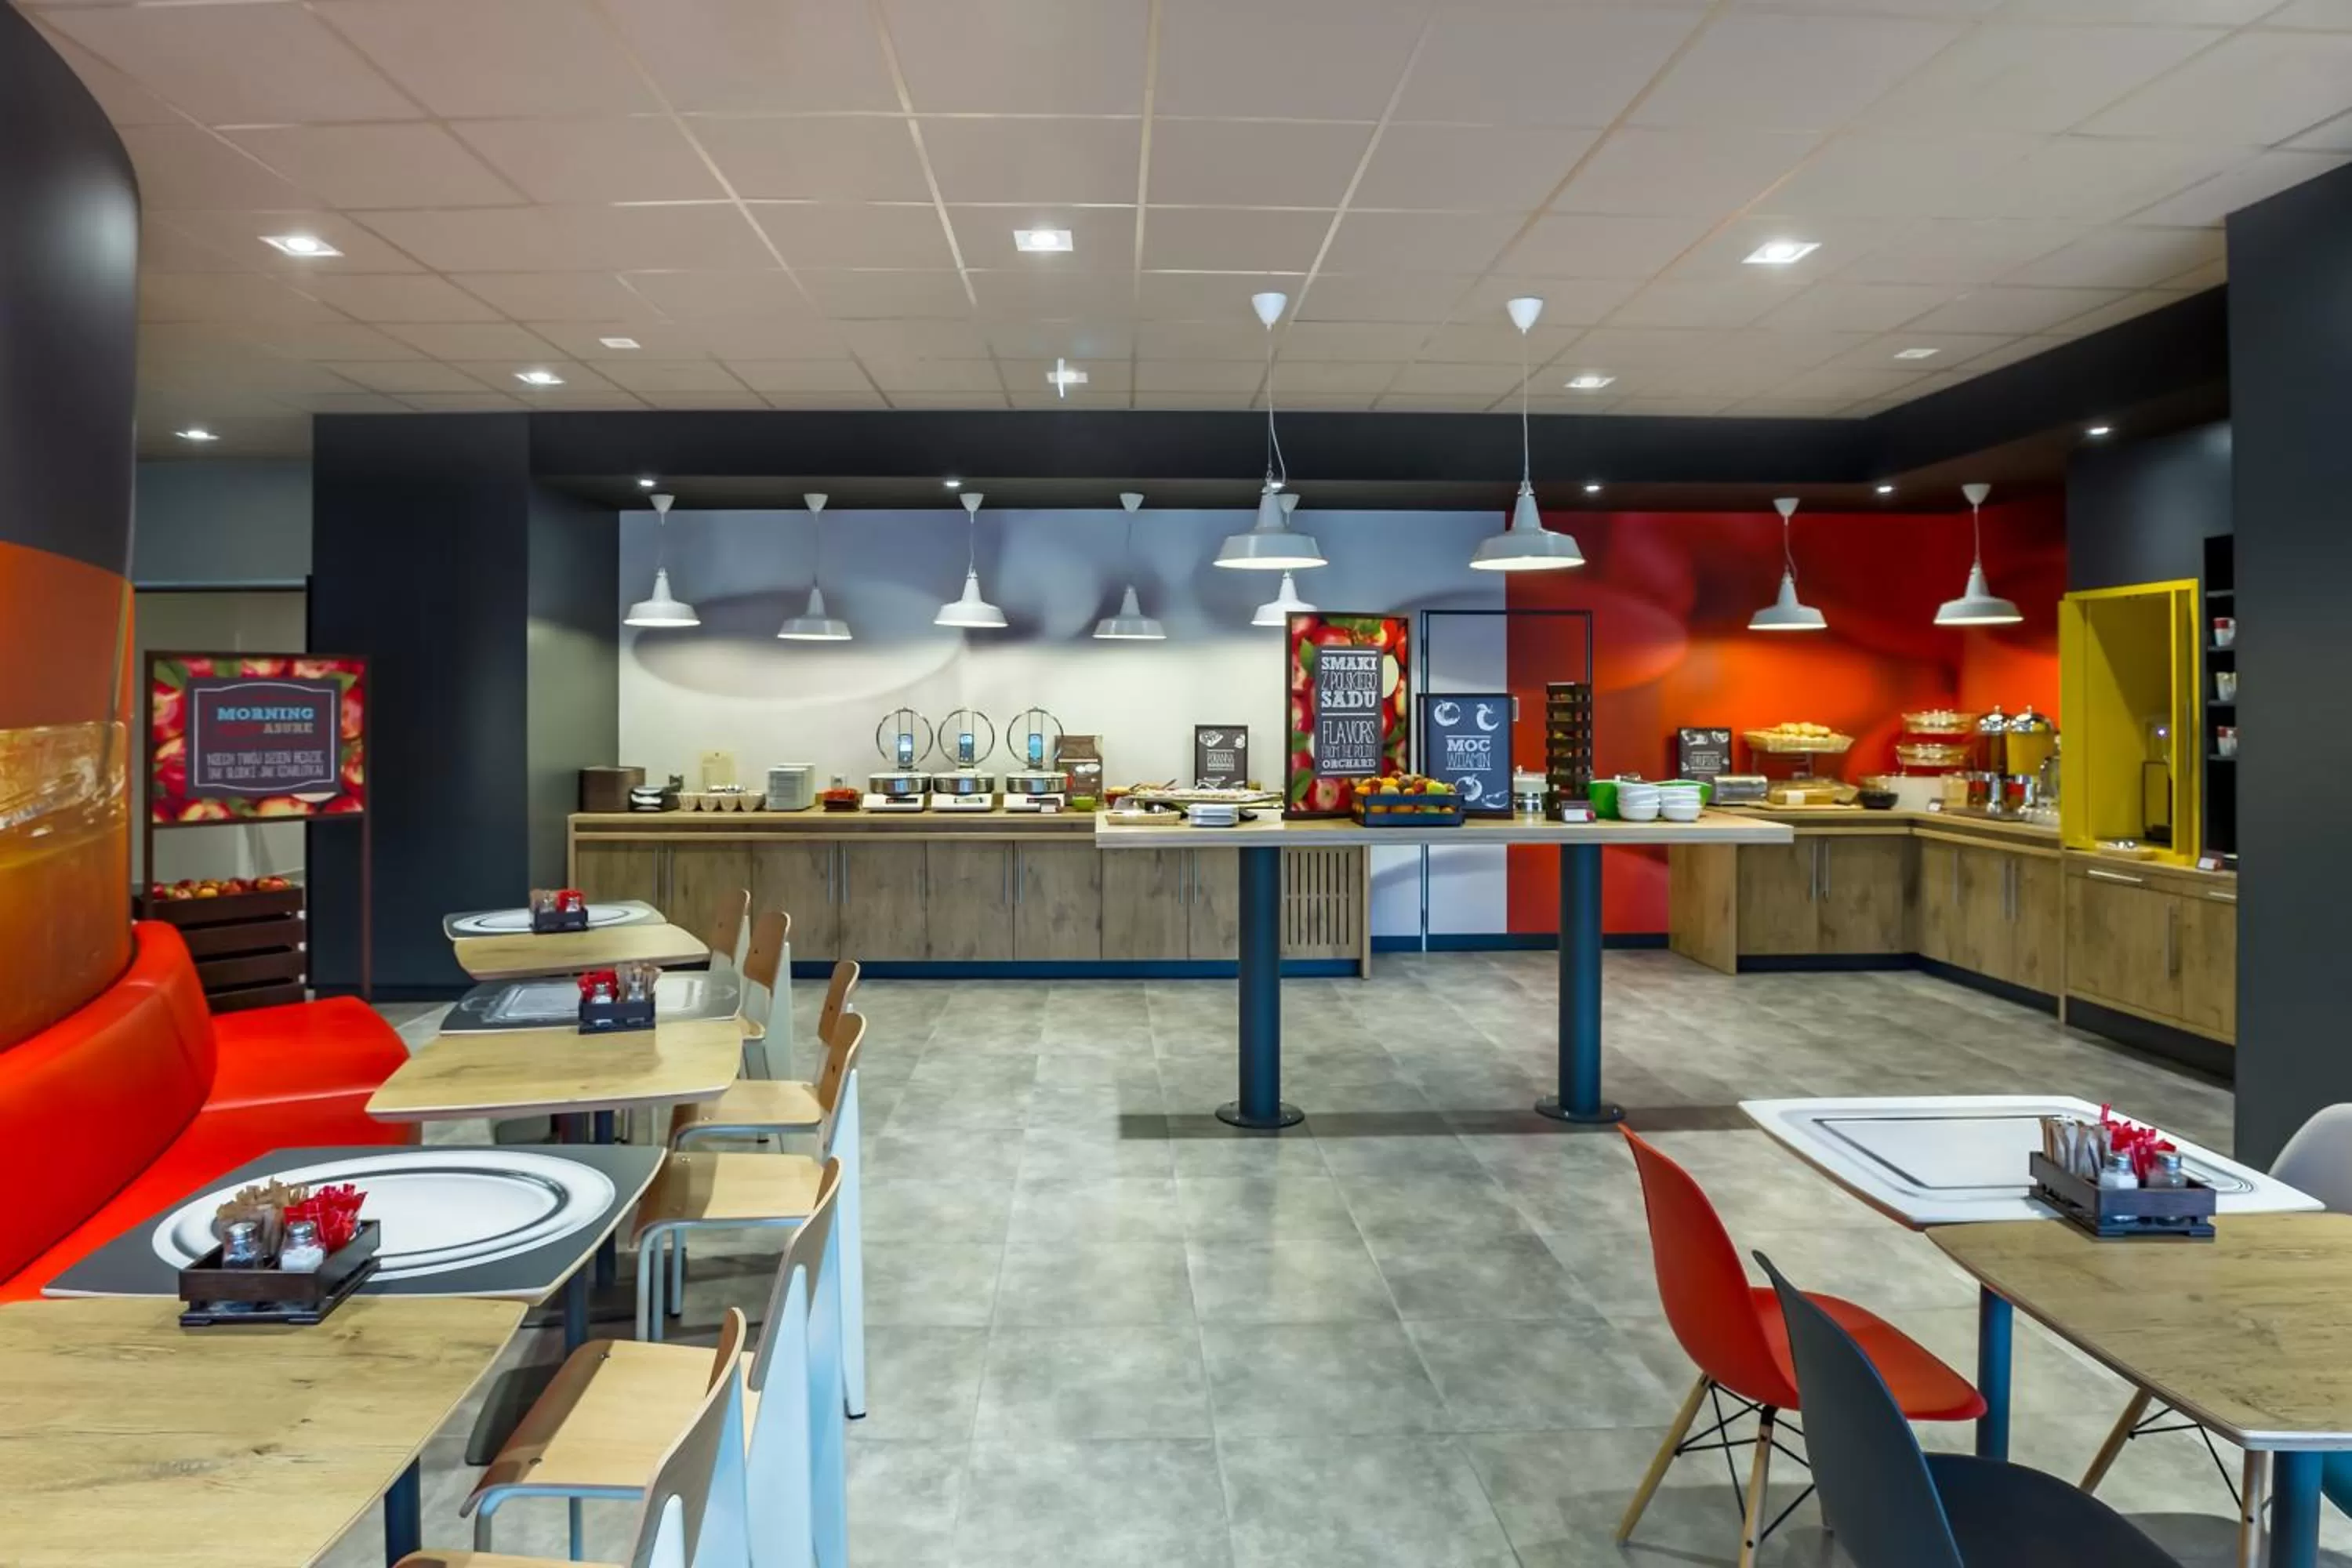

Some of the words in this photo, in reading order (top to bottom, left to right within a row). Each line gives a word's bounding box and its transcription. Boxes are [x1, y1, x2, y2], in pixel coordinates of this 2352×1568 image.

[1321, 656, 1377, 670] SMAKI
[1321, 691, 1377, 708] SADU
[217, 706, 314, 721] MORNING
[1323, 720, 1375, 744] FLAVORS
[1446, 739, 1490, 752] MOC
[1323, 759, 1376, 769] ORCHARD
[1446, 752, 1490, 768] WITAMIN
